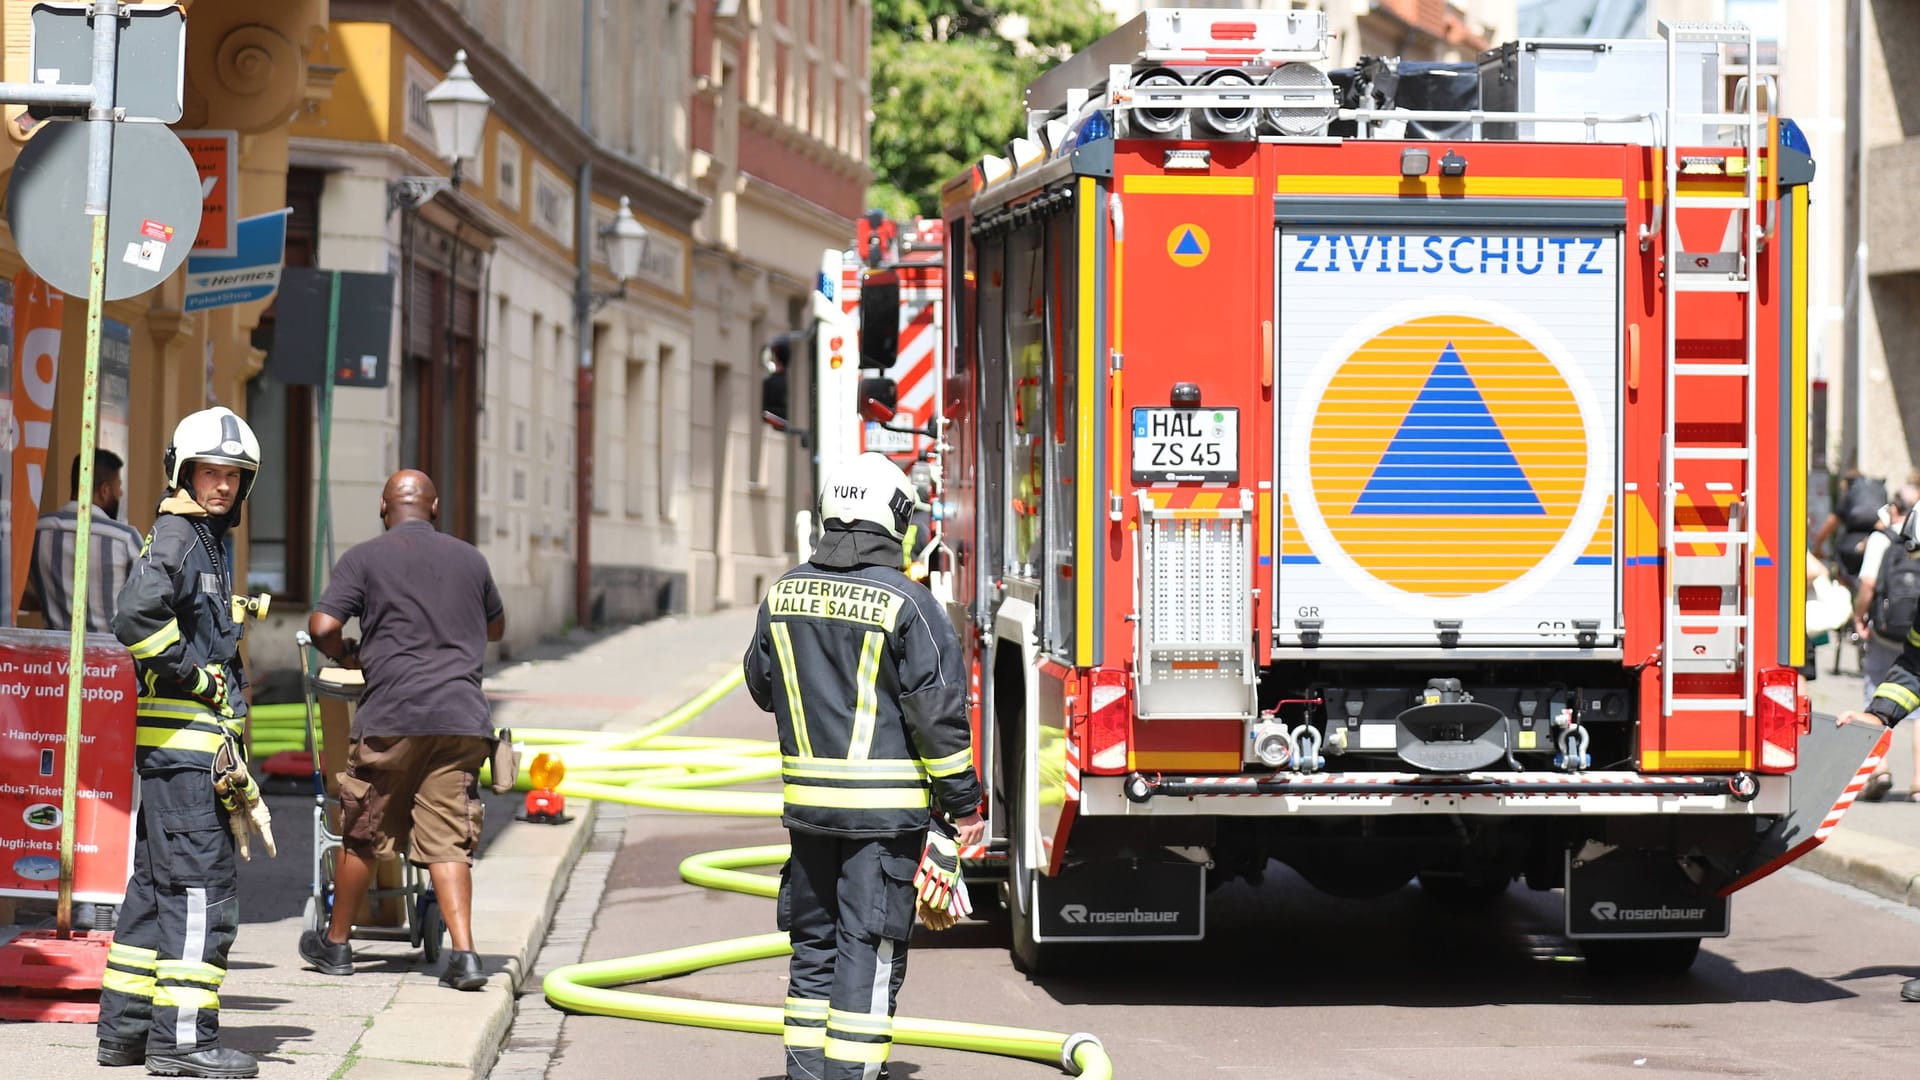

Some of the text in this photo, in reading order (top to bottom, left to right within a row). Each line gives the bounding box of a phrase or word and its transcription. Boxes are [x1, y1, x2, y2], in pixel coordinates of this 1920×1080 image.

[1295, 235, 1603, 275] ZIVILSCHUTZ
[211, 269, 275, 287] Hermes
[190, 291, 252, 306] PaketShop
[1153, 413, 1202, 437] HAL
[1152, 443, 1221, 466] ZS 45
[834, 485, 868, 500] YURY
[1298, 606, 1319, 618] GR
[24, 662, 52, 674] und
[57, 662, 118, 678] Vkauf
[0, 683, 124, 703] ndy und aptop
[9, 729, 97, 744] Handyrepatur
[75, 788, 113, 800] uchen
[0, 838, 53, 852] lugtickets
[1090, 908, 1180, 923] rosenbauer
[1619, 905, 1706, 920] rosenbauer
